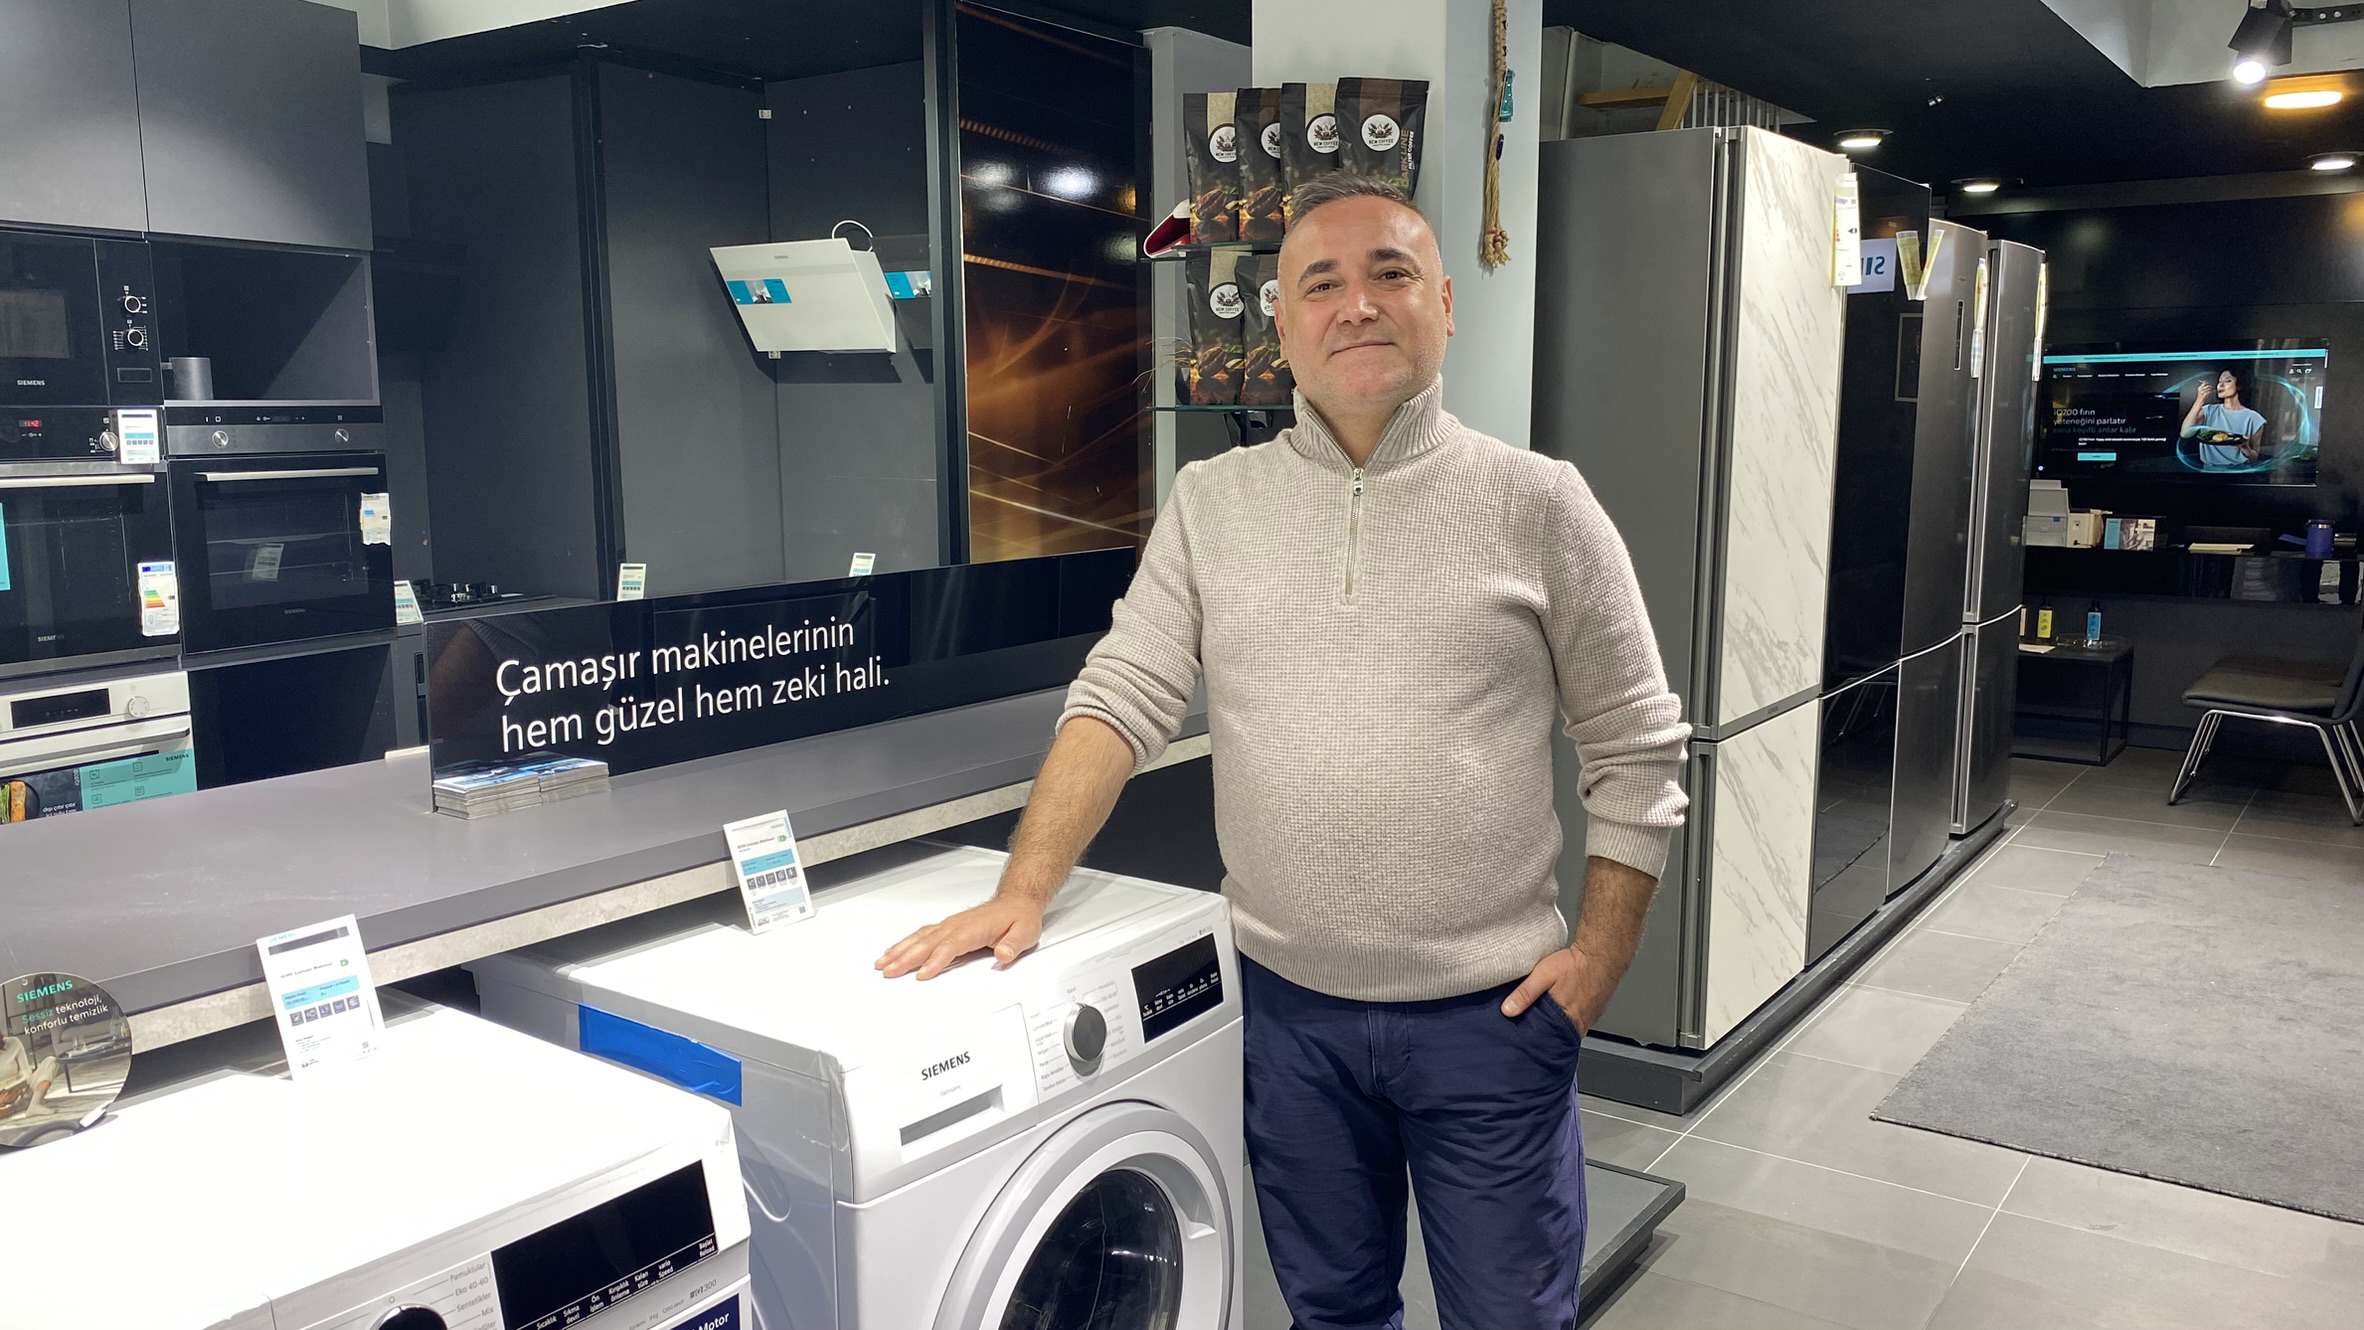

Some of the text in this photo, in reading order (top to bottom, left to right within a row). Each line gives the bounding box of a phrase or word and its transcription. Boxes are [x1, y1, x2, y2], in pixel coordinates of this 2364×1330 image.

[1401, 130, 1409, 187] DARK LINE
[2053, 417, 2126, 427] yeteneğini parlatır
[496, 616, 855, 706] Çamaşır makinelerinin
[502, 656, 890, 752] hem güzel hem zeki hali.
[166, 753, 189, 762] SIEMENS
[16, 980, 73, 1003] SIEMENS
[22, 994, 103, 1024] Sessiz teknoloji,
[24, 1005, 109, 1035] konforlu temizlik
[921, 1051, 971, 1081] SIEMENS
[450, 1262, 486, 1282] Pamuklular
[634, 1271, 649, 1282] Kalan
[658, 1265, 674, 1279] Speed
[455, 1276, 489, 1297] Eko 40-60
[638, 1279, 649, 1289] süre
[456, 1292, 491, 1312] Sentetikler
[591, 1295, 600, 1303] Ön
[611, 1289, 630, 1302] önleme
[481, 1306, 494, 1316] Mix
[698, 1313, 730, 1330] Motor
